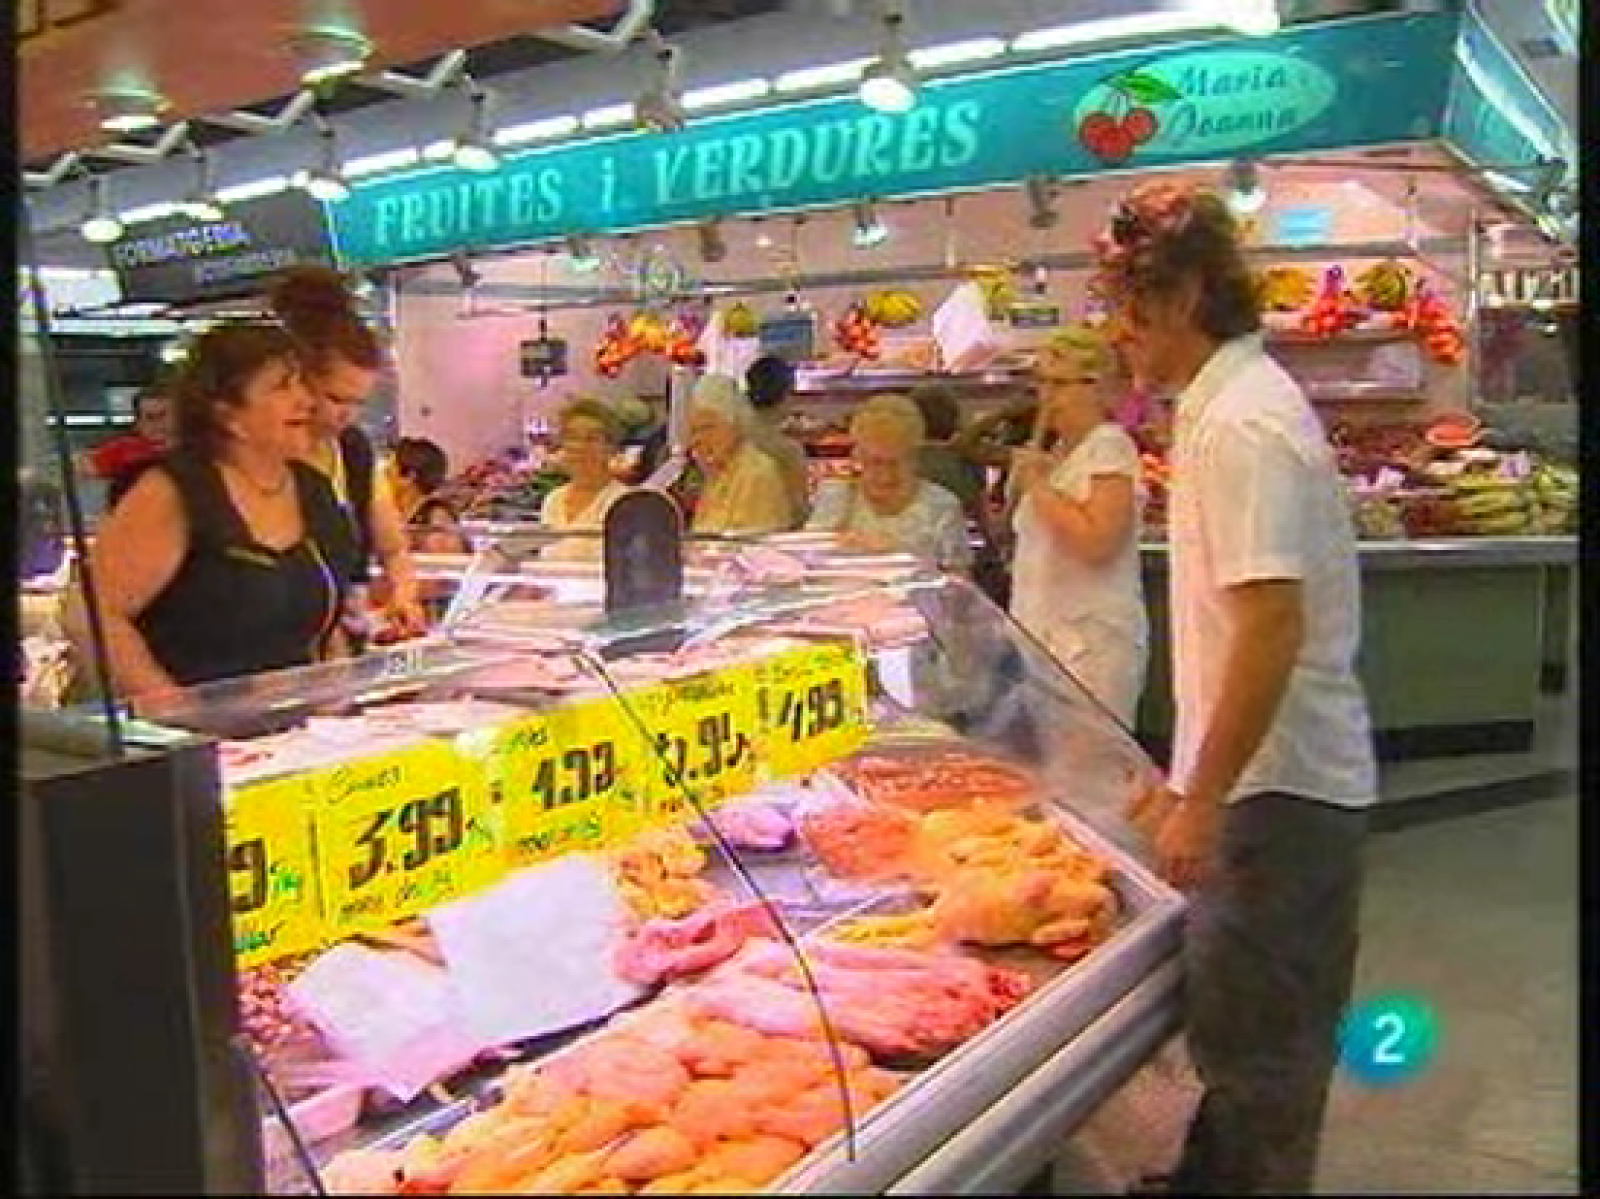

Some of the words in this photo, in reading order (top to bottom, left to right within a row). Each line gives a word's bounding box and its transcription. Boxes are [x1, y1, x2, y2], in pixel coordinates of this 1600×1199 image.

[1180, 65, 1287, 97] Maria
[374, 168, 564, 246] FRUITES
[653, 100, 981, 205] VERDURES
